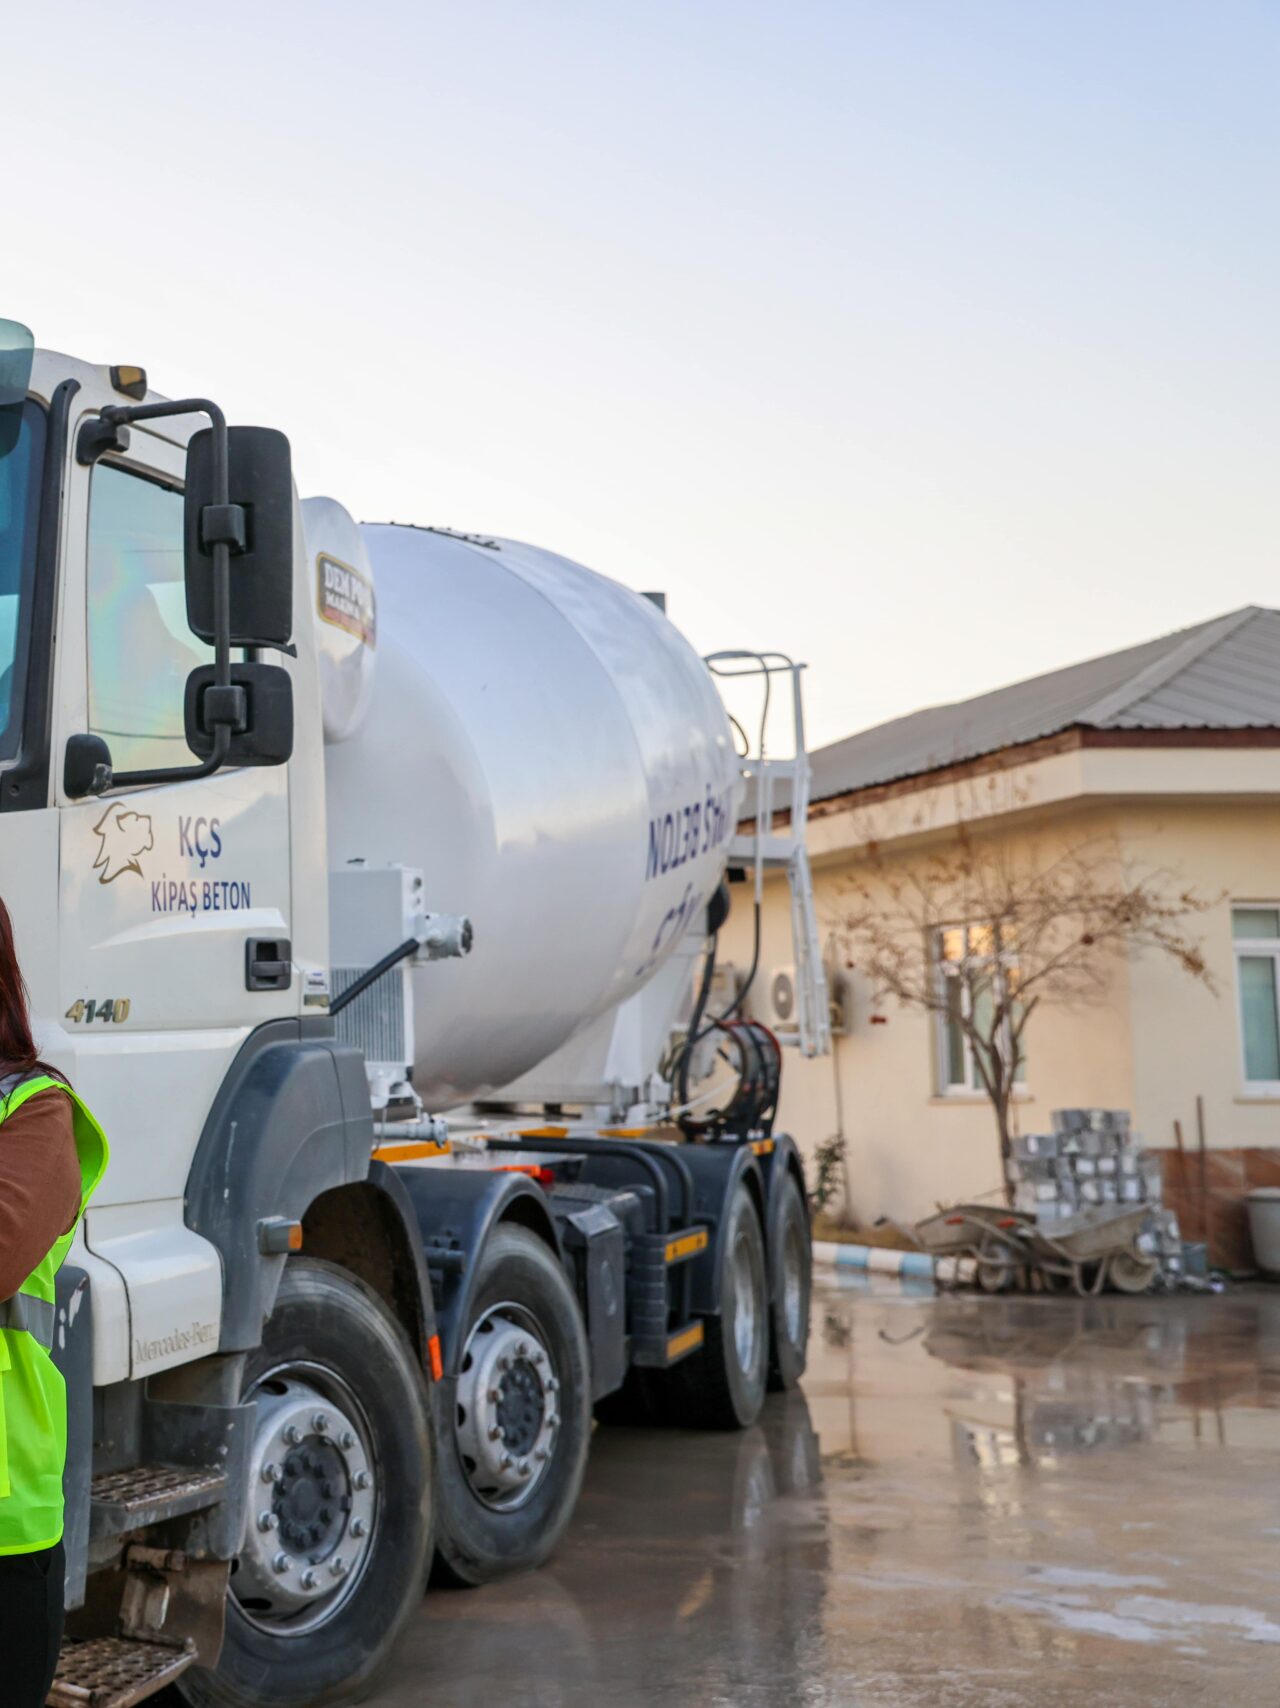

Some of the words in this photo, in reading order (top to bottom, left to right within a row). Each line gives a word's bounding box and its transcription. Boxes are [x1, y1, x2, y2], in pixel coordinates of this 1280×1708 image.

[178, 815, 222, 868] KÇS
[151, 873, 198, 918] KİPAŞ
[203, 881, 251, 911] BETON
[65, 998, 131, 1024] 4140
